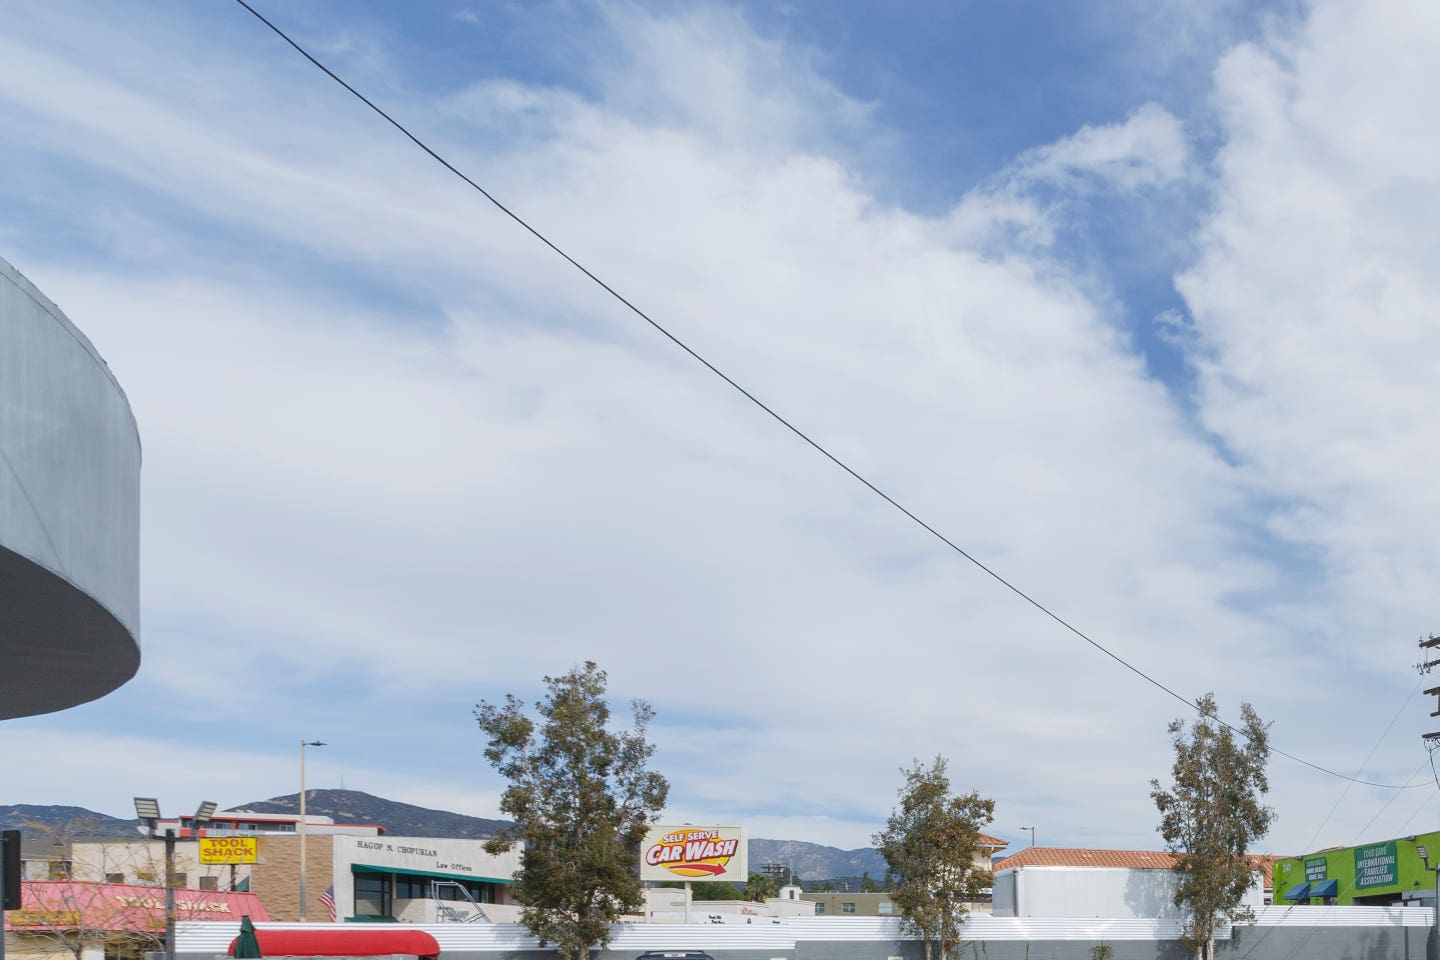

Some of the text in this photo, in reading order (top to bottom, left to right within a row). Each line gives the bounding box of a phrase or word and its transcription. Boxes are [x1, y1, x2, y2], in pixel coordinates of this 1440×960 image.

[209, 839, 248, 847] TOOL
[663, 830, 718, 843] SELF SERVE
[203, 848, 253, 857] SHACK
[357, 841, 383, 850] HAGOP
[397, 846, 438, 857] CHOPURIAN
[646, 839, 738, 866] CAR WASH
[437, 861, 472, 872] Law Offices
[1357, 855, 1395, 869] INTERNATIONAL
[1364, 866, 1388, 877] FAMILIES
[1360, 873, 1394, 886] ASSOCIATION
